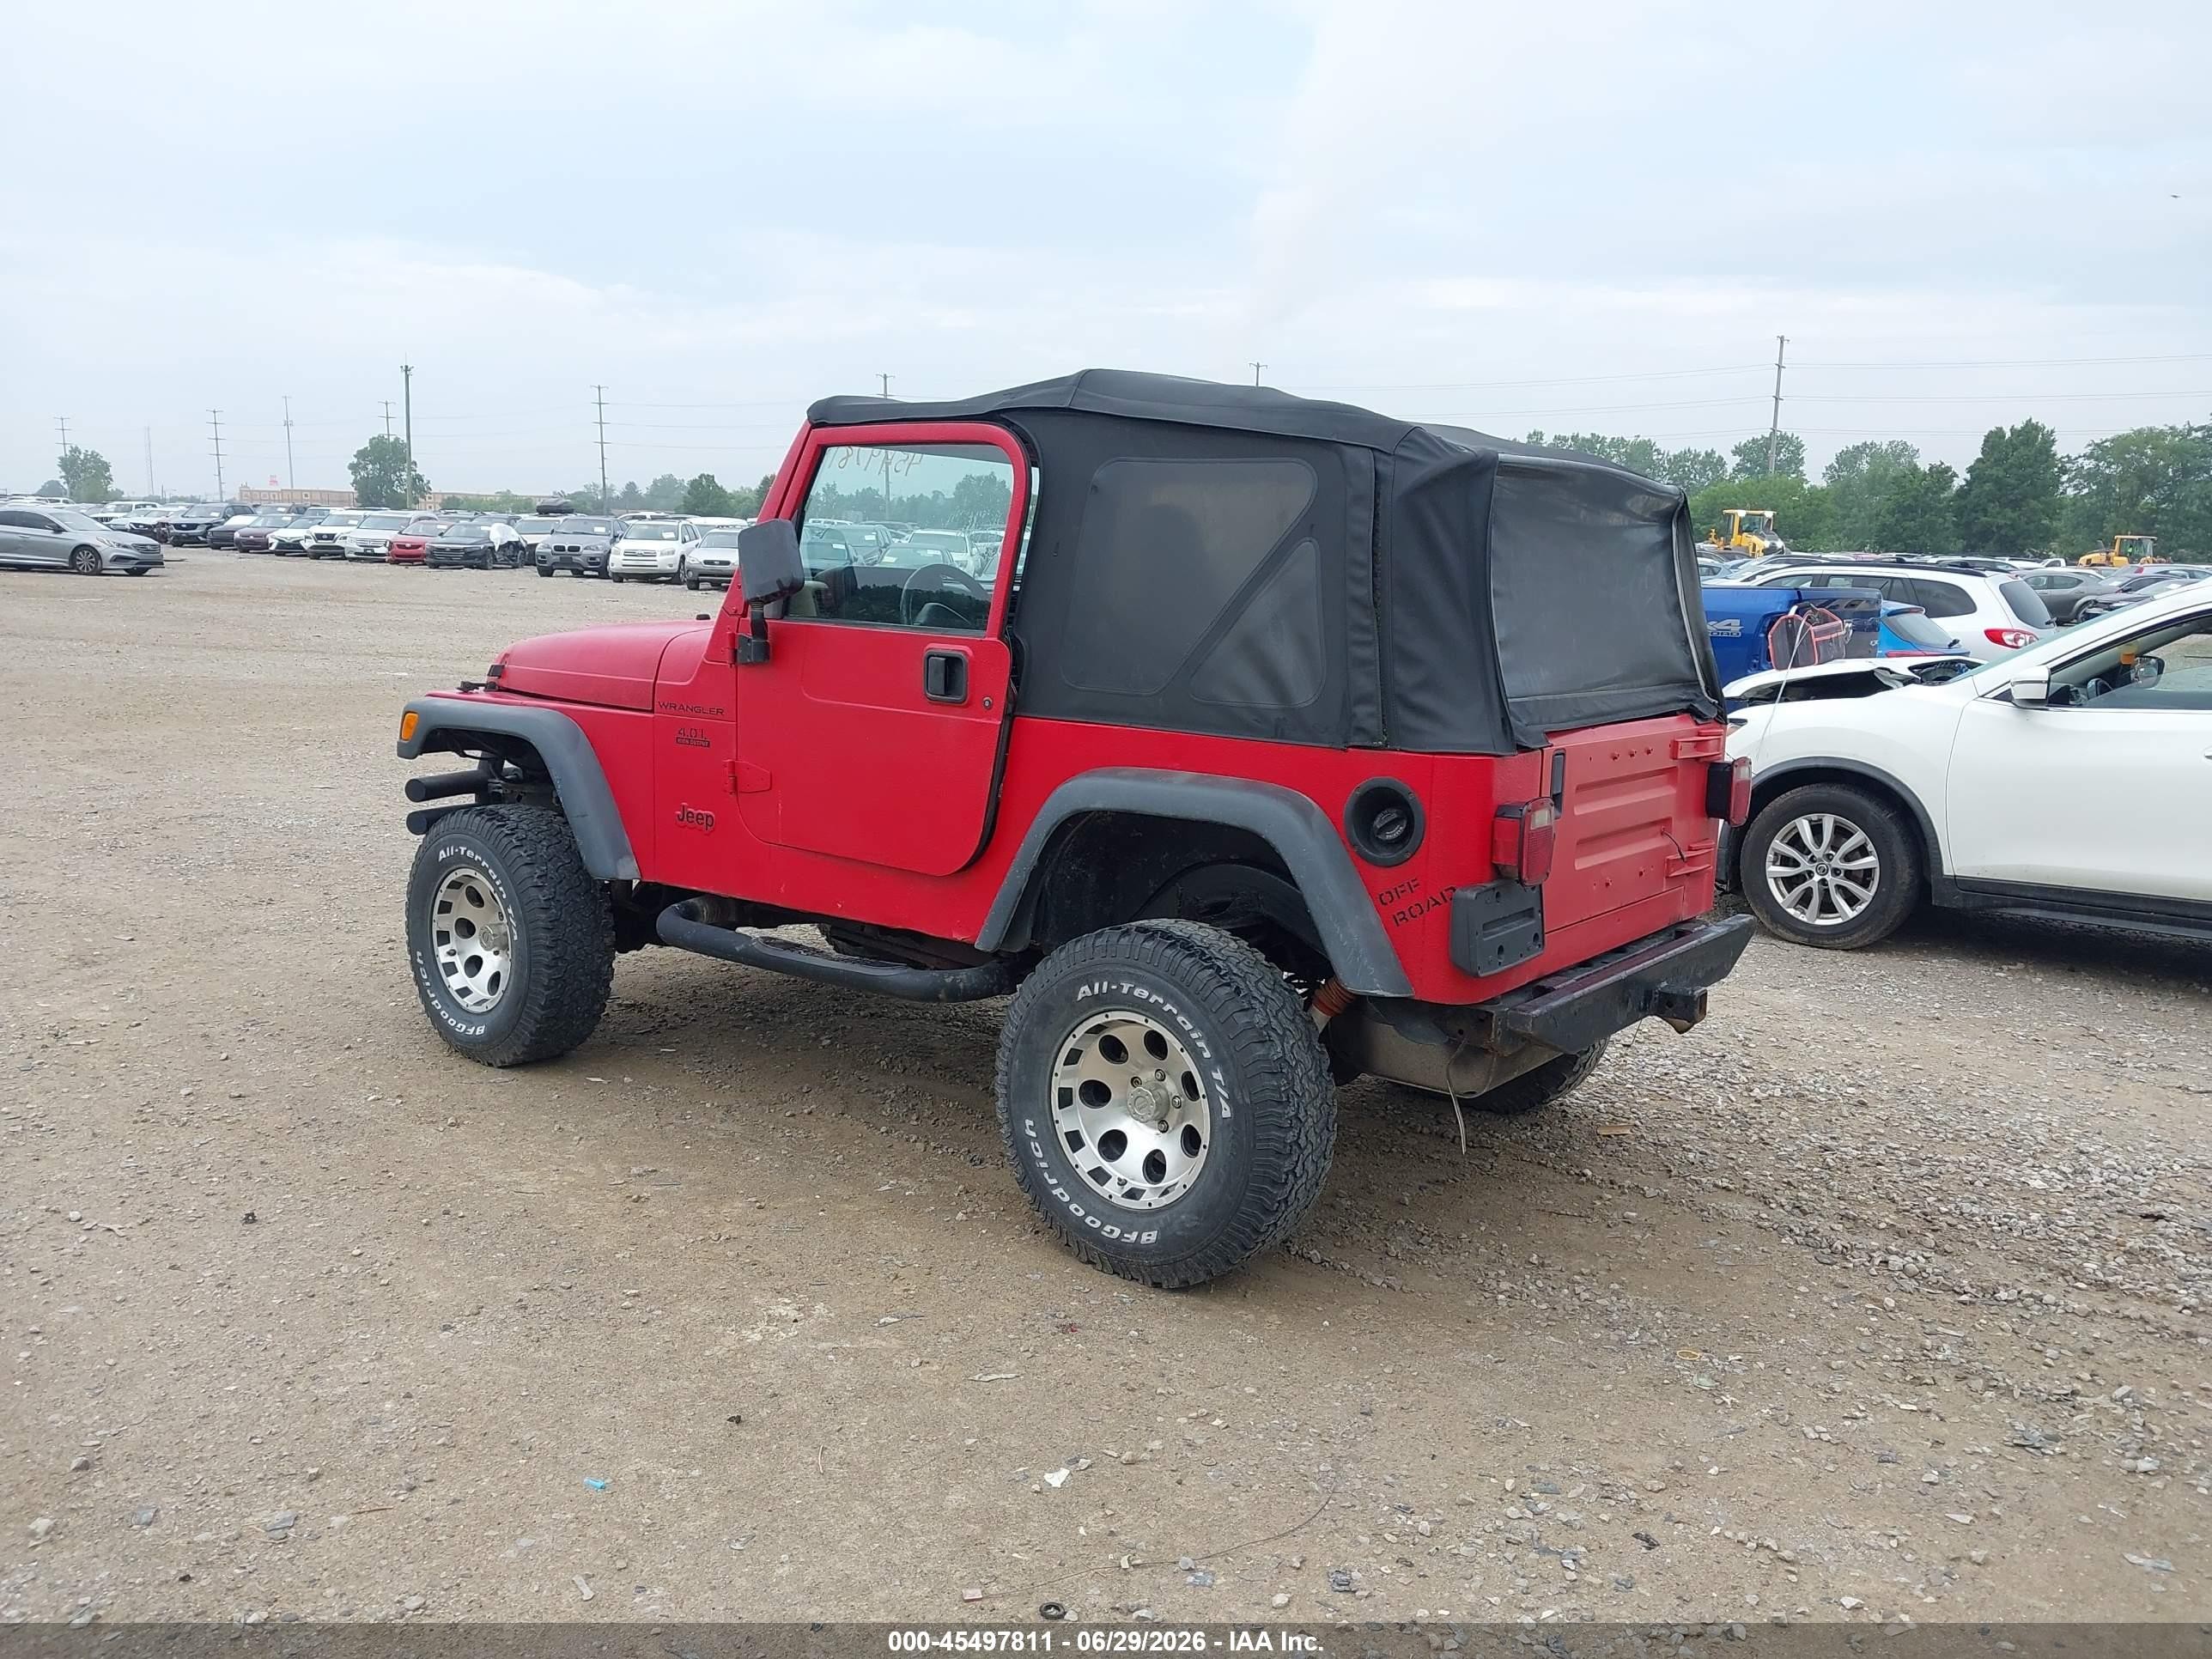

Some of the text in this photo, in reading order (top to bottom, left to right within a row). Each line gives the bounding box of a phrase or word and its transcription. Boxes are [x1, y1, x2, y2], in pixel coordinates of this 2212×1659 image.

[659, 701, 725, 715] WRANGLER
[677, 805, 714, 830] Jeep
[438, 846, 519, 941] All-Terrain T/A
[1379, 878, 1420, 905] OFF
[1393, 886, 1457, 927] ROAD
[416, 951, 487, 1036] BFGoodrich
[1076, 980, 1234, 1120] All-Terrain T/A
[1024, 1119, 1159, 1245] BFGoodrich
